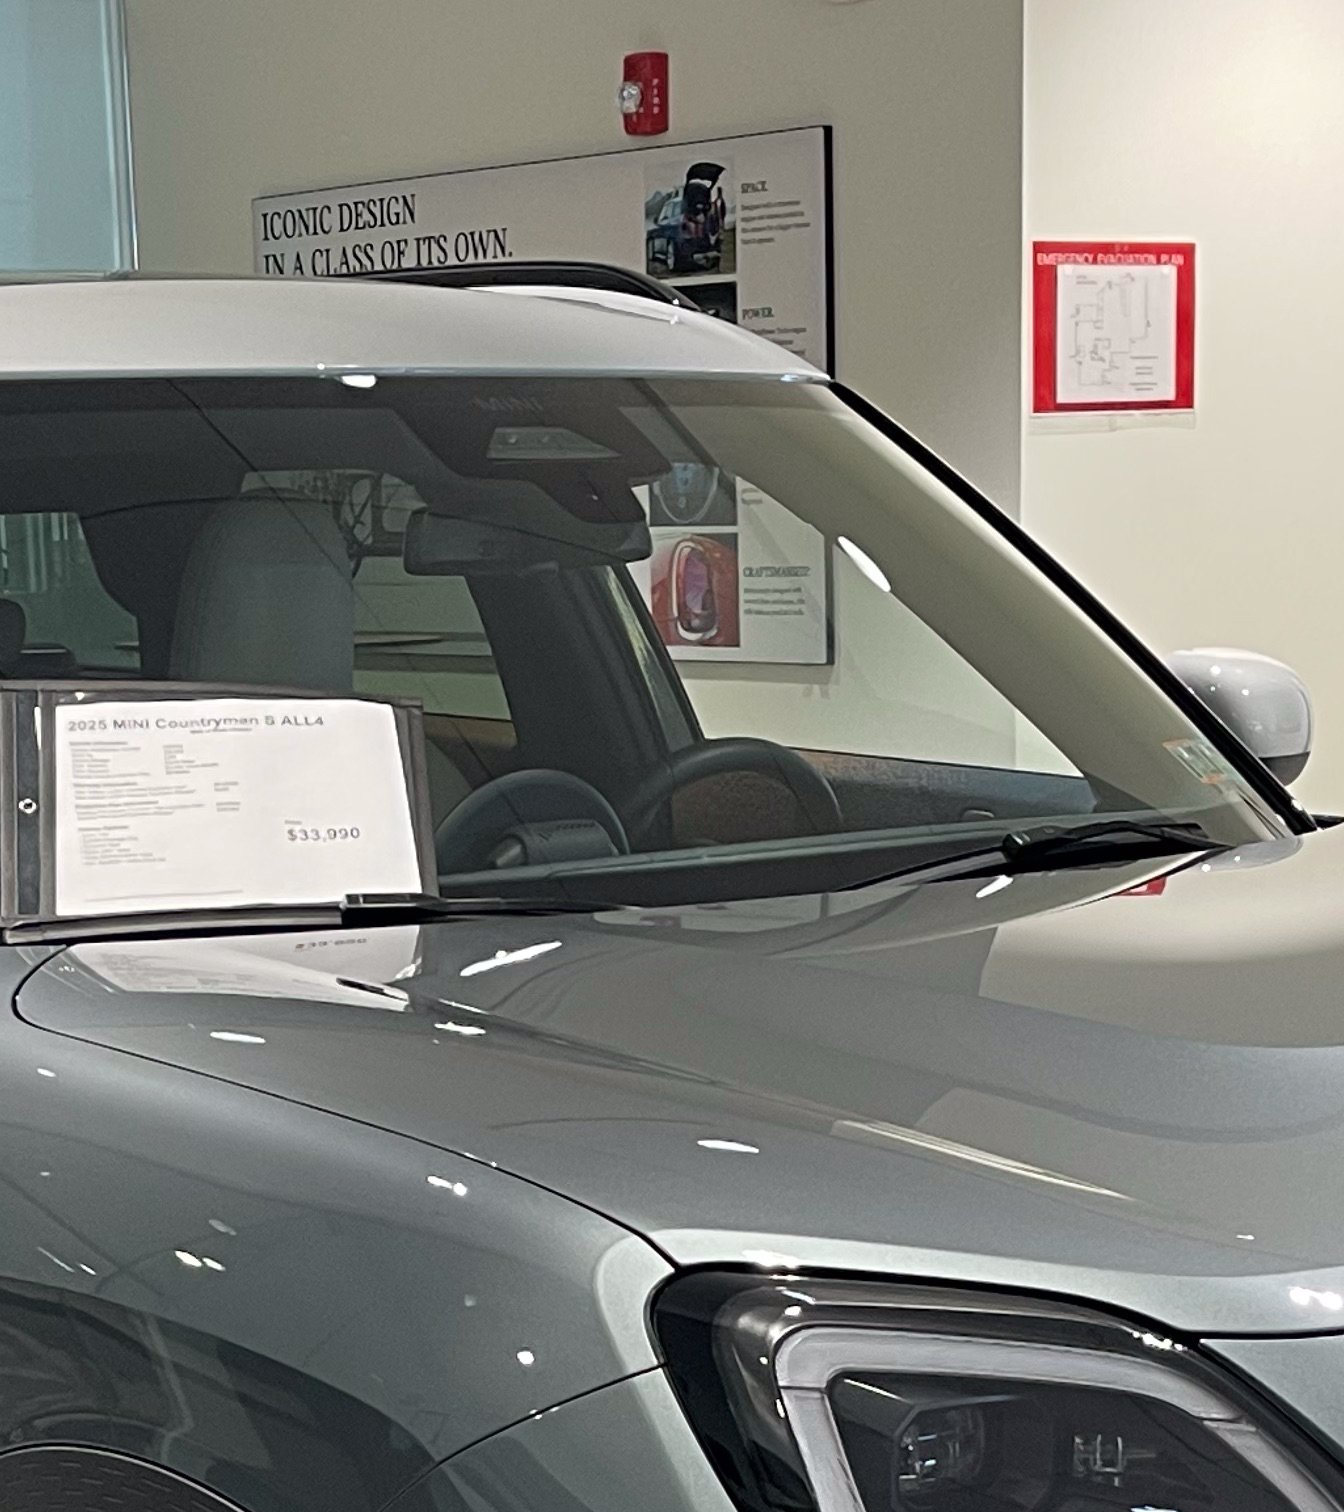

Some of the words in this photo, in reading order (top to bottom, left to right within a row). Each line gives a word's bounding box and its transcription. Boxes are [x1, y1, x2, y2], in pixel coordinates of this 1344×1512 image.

[262, 205, 332, 241] ICONIC
[338, 194, 416, 232] DESIGN
[264, 253, 285, 275] IN
[293, 251, 304, 276] A
[311, 243, 374, 276] CLASS
[381, 239, 408, 270] OF
[415, 235, 448, 266] ITS
[455, 228, 513, 262] OWN.
[1160, 253, 1184, 265] PLAN
[67, 719, 107, 731] 2025
[112, 718, 150, 730] MINI
[155, 716, 258, 731] Countryman
[281, 715, 324, 726] ALL4
[287, 827, 360, 842] $33,990
